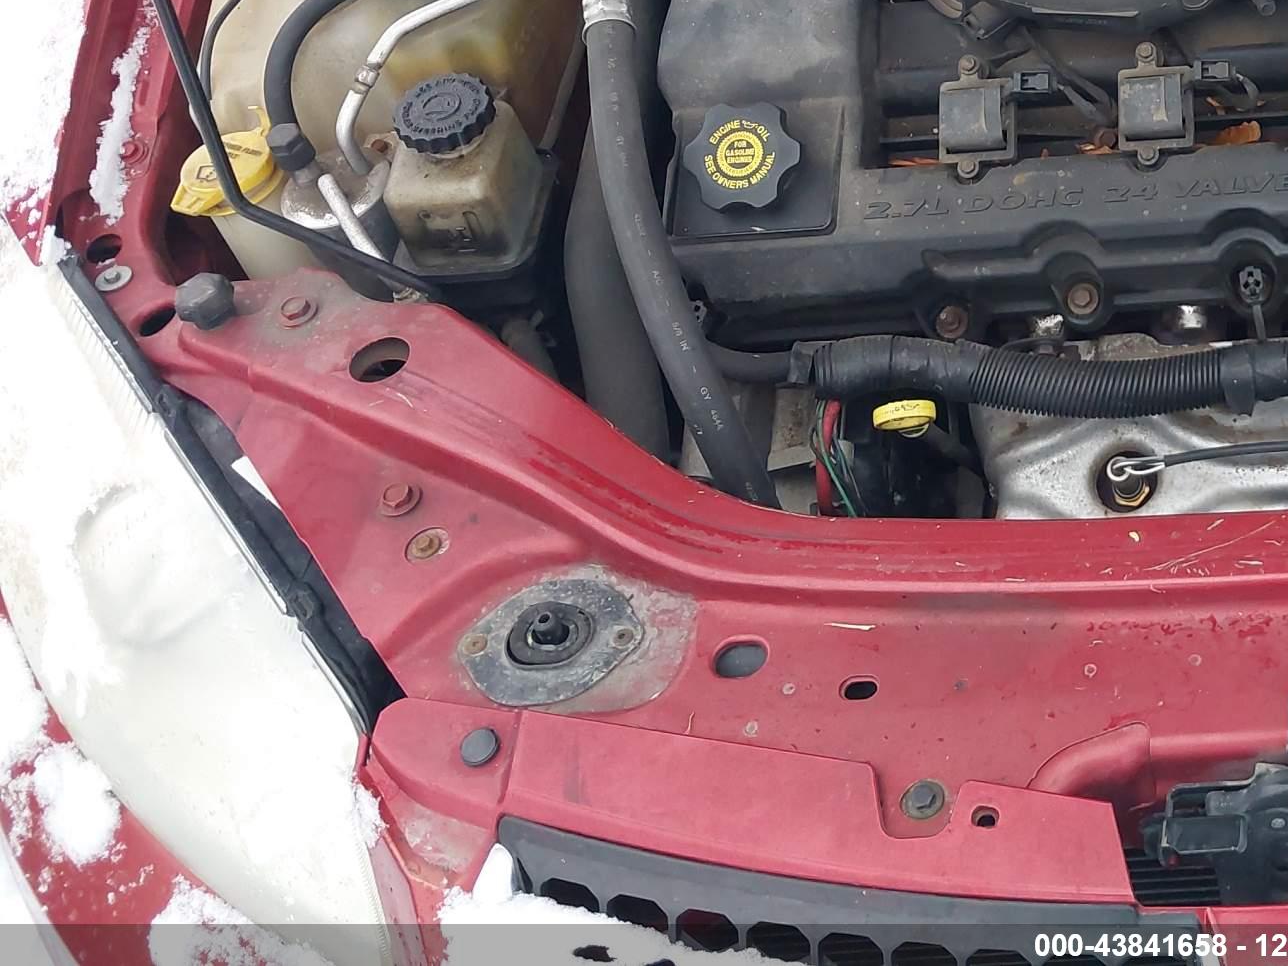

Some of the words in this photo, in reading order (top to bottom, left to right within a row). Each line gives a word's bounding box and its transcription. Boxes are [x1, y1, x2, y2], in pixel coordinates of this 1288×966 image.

[709, 120, 740, 145] ENGINE
[756, 126, 771, 142] OIL
[725, 148, 755, 156] GASOLINE
[704, 154, 716, 174] SEE
[712, 172, 749, 189] OWNERS
[749, 151, 776, 185] MANUAL
[864, 200, 949, 221] 2.7L
[962, 186, 1084, 214] DOHC
[1102, 183, 1158, 203] 24
[700, 386, 712, 401] GY
